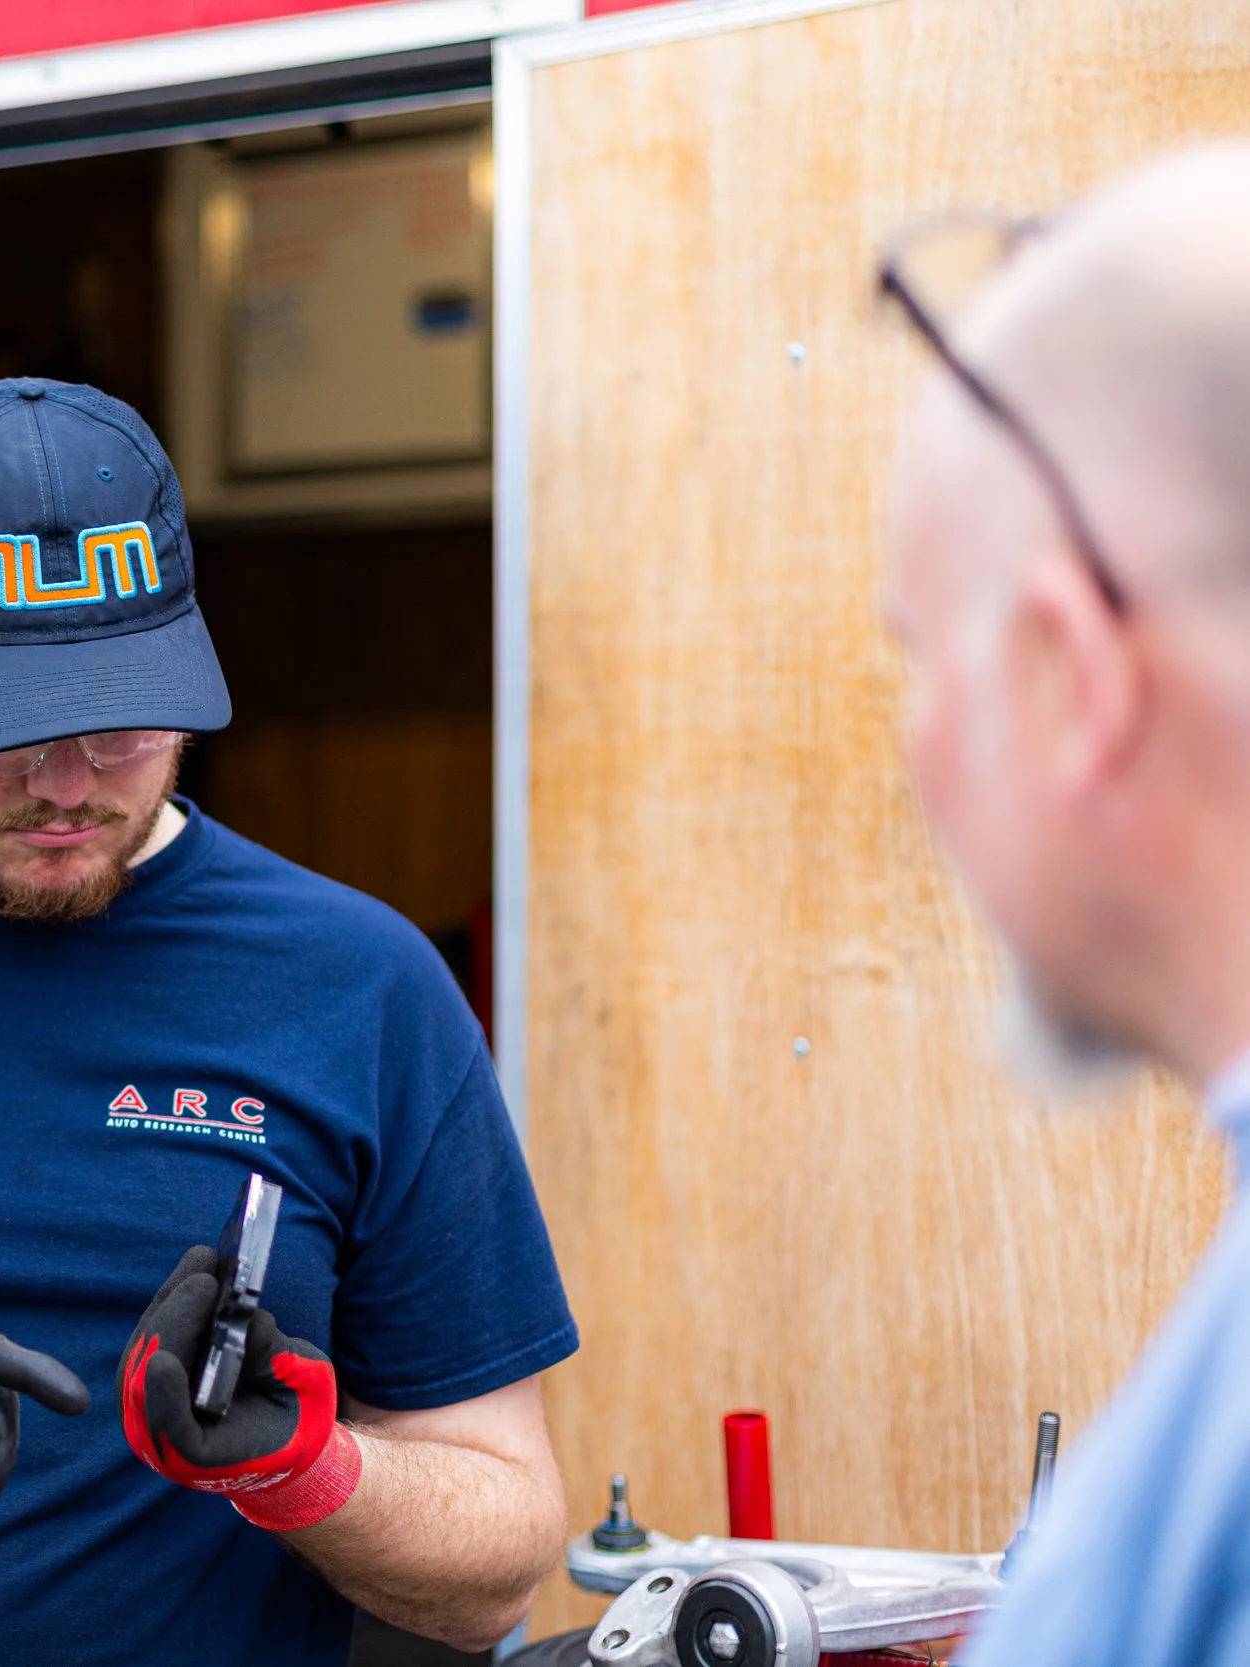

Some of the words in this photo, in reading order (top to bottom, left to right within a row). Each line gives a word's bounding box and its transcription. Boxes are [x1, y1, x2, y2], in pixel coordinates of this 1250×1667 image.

[106, 1118, 139, 1129] AUTO
[144, 1120, 211, 1135] RESEARCH
[219, 1129, 266, 1144] CENTER
